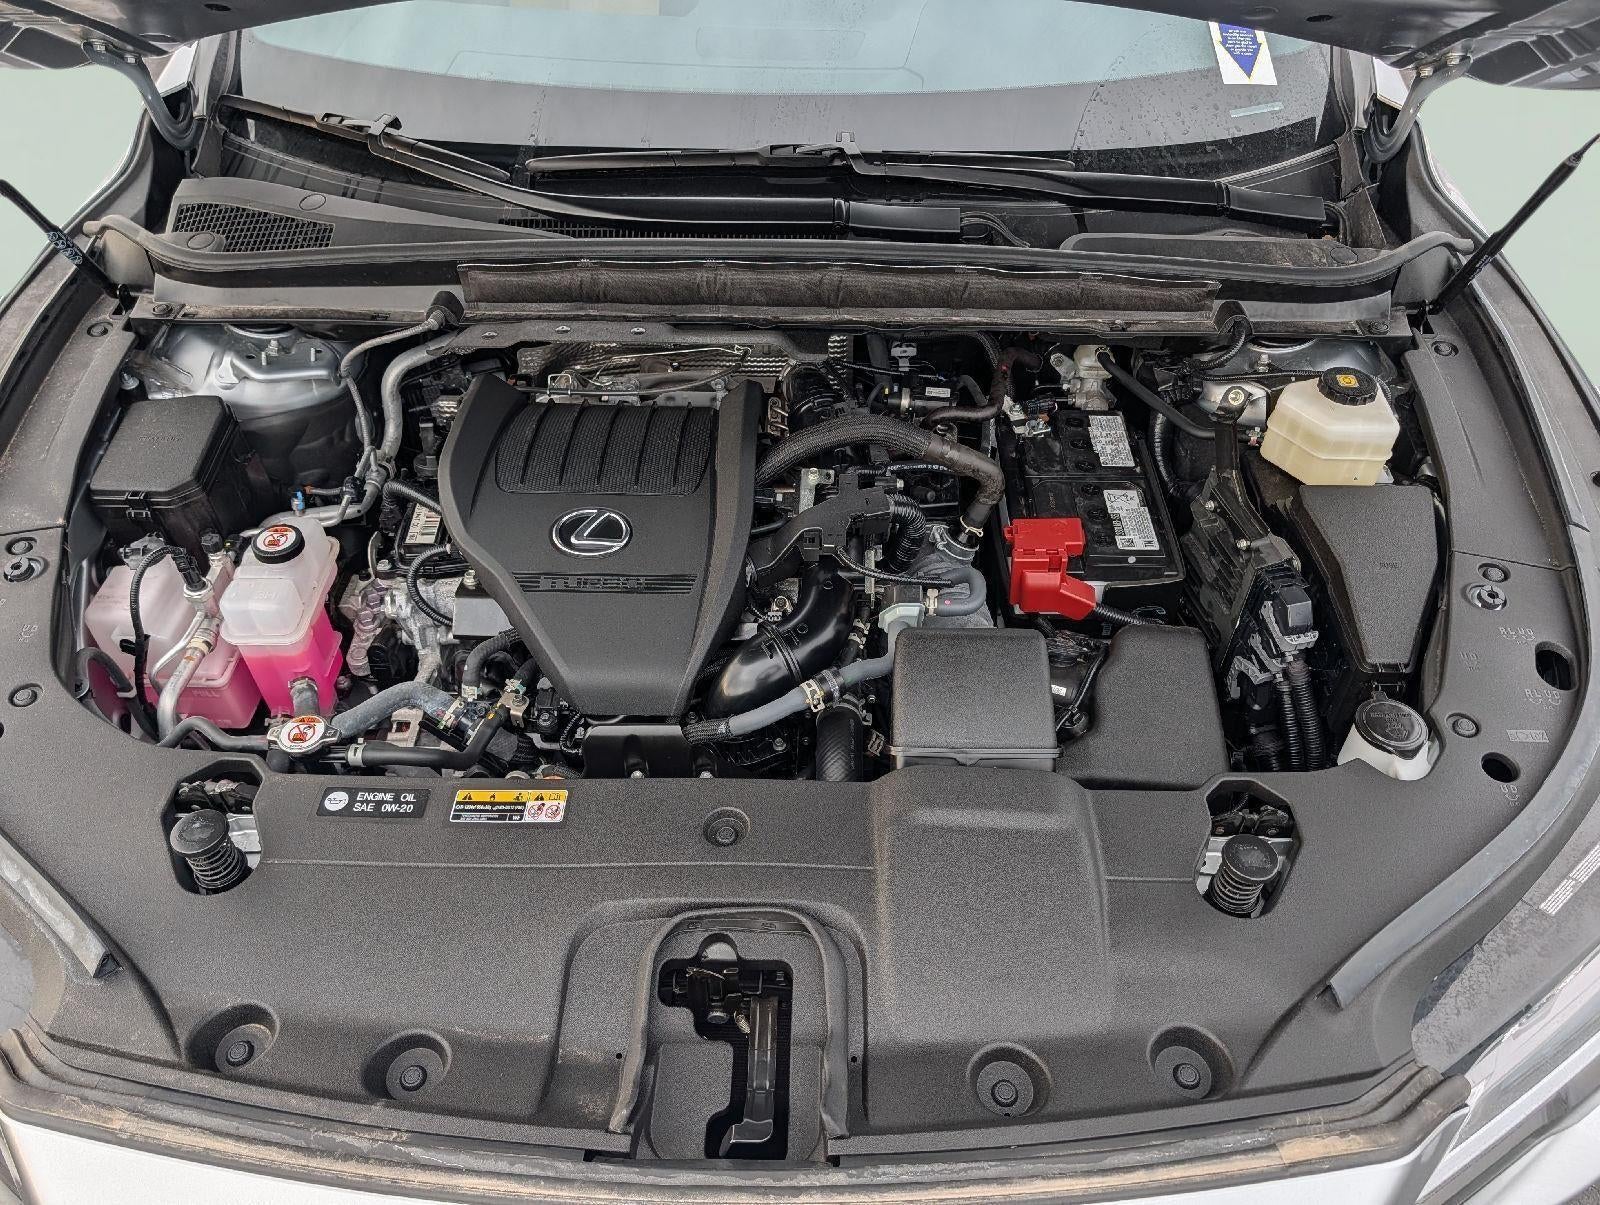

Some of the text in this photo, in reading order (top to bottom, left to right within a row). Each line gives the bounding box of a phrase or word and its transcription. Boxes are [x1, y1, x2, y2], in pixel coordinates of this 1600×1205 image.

[356, 792, 417, 802] ENGINE OIL
[352, 802, 414, 813] SAE 0W-20
